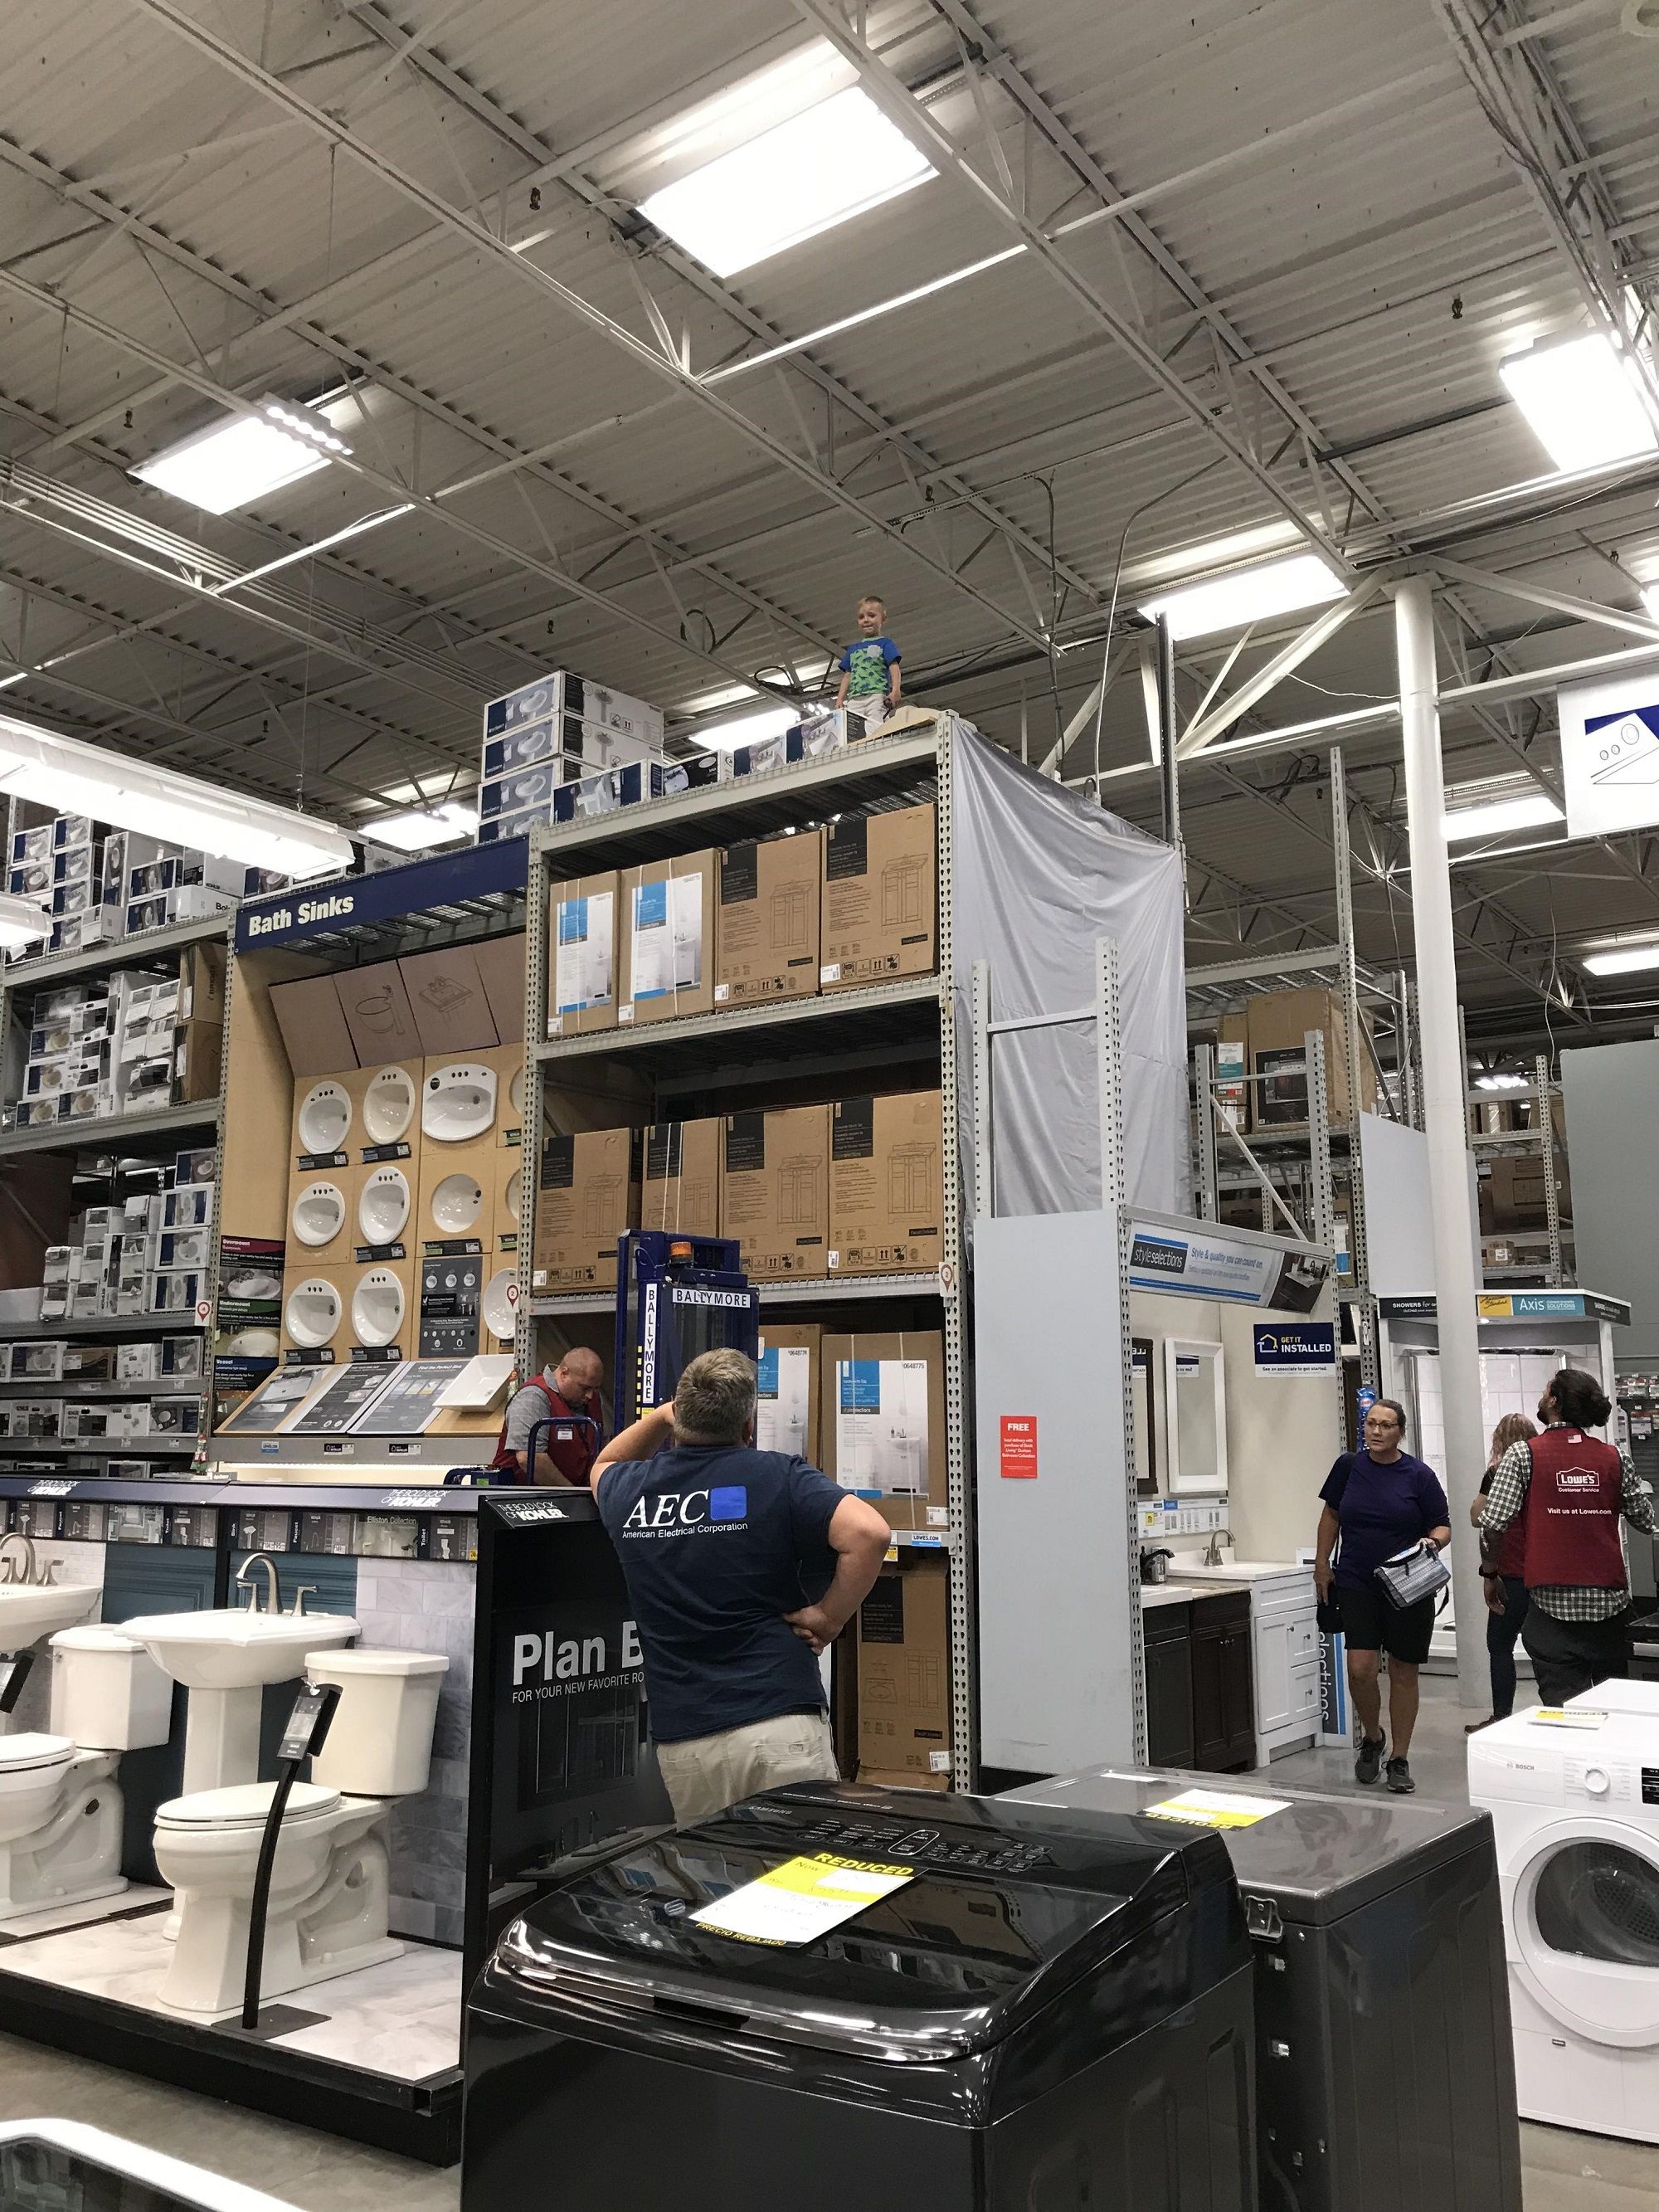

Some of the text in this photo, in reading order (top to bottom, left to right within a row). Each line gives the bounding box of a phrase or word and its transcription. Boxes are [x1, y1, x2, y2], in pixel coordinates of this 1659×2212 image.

[249, 896, 354, 937] Bath Sinks
[1191, 1247, 1204, 1259] Style
[1204, 1250, 1209, 1259] &
[1209, 1252, 1225, 1264] quality
[1225, 1255, 1234, 1264] you
[1242, 1258, 1256, 1268] count
[677, 1289, 747, 1306] BALLYMORE
[1520, 1298, 1545, 1311] Axis
[645, 1289, 655, 1399] BALLYMORE
[1281, 1343, 1331, 1352] INSTALLED
[1007, 1423, 1029, 1431] FREE
[497, 1503, 515, 1511] THE
[533, 1501, 558, 1510] LOOK
[622, 1488, 709, 1528] AEC
[367, 1515, 416, 1525] Elliston Collection
[622, 1523, 748, 1539] American Electrical Corporation
[513, 1630, 606, 1685] Plan
[512, 1671, 645, 1703] FOR YOUR NEW FAVORITE RO
[748, 1805, 793, 1815] SAMSUNG
[1145, 1812, 1234, 1830] REDUCED
[813, 1852, 914, 1876] REDUCED
[695, 1922, 787, 1946] PRECIO REBAJADO
